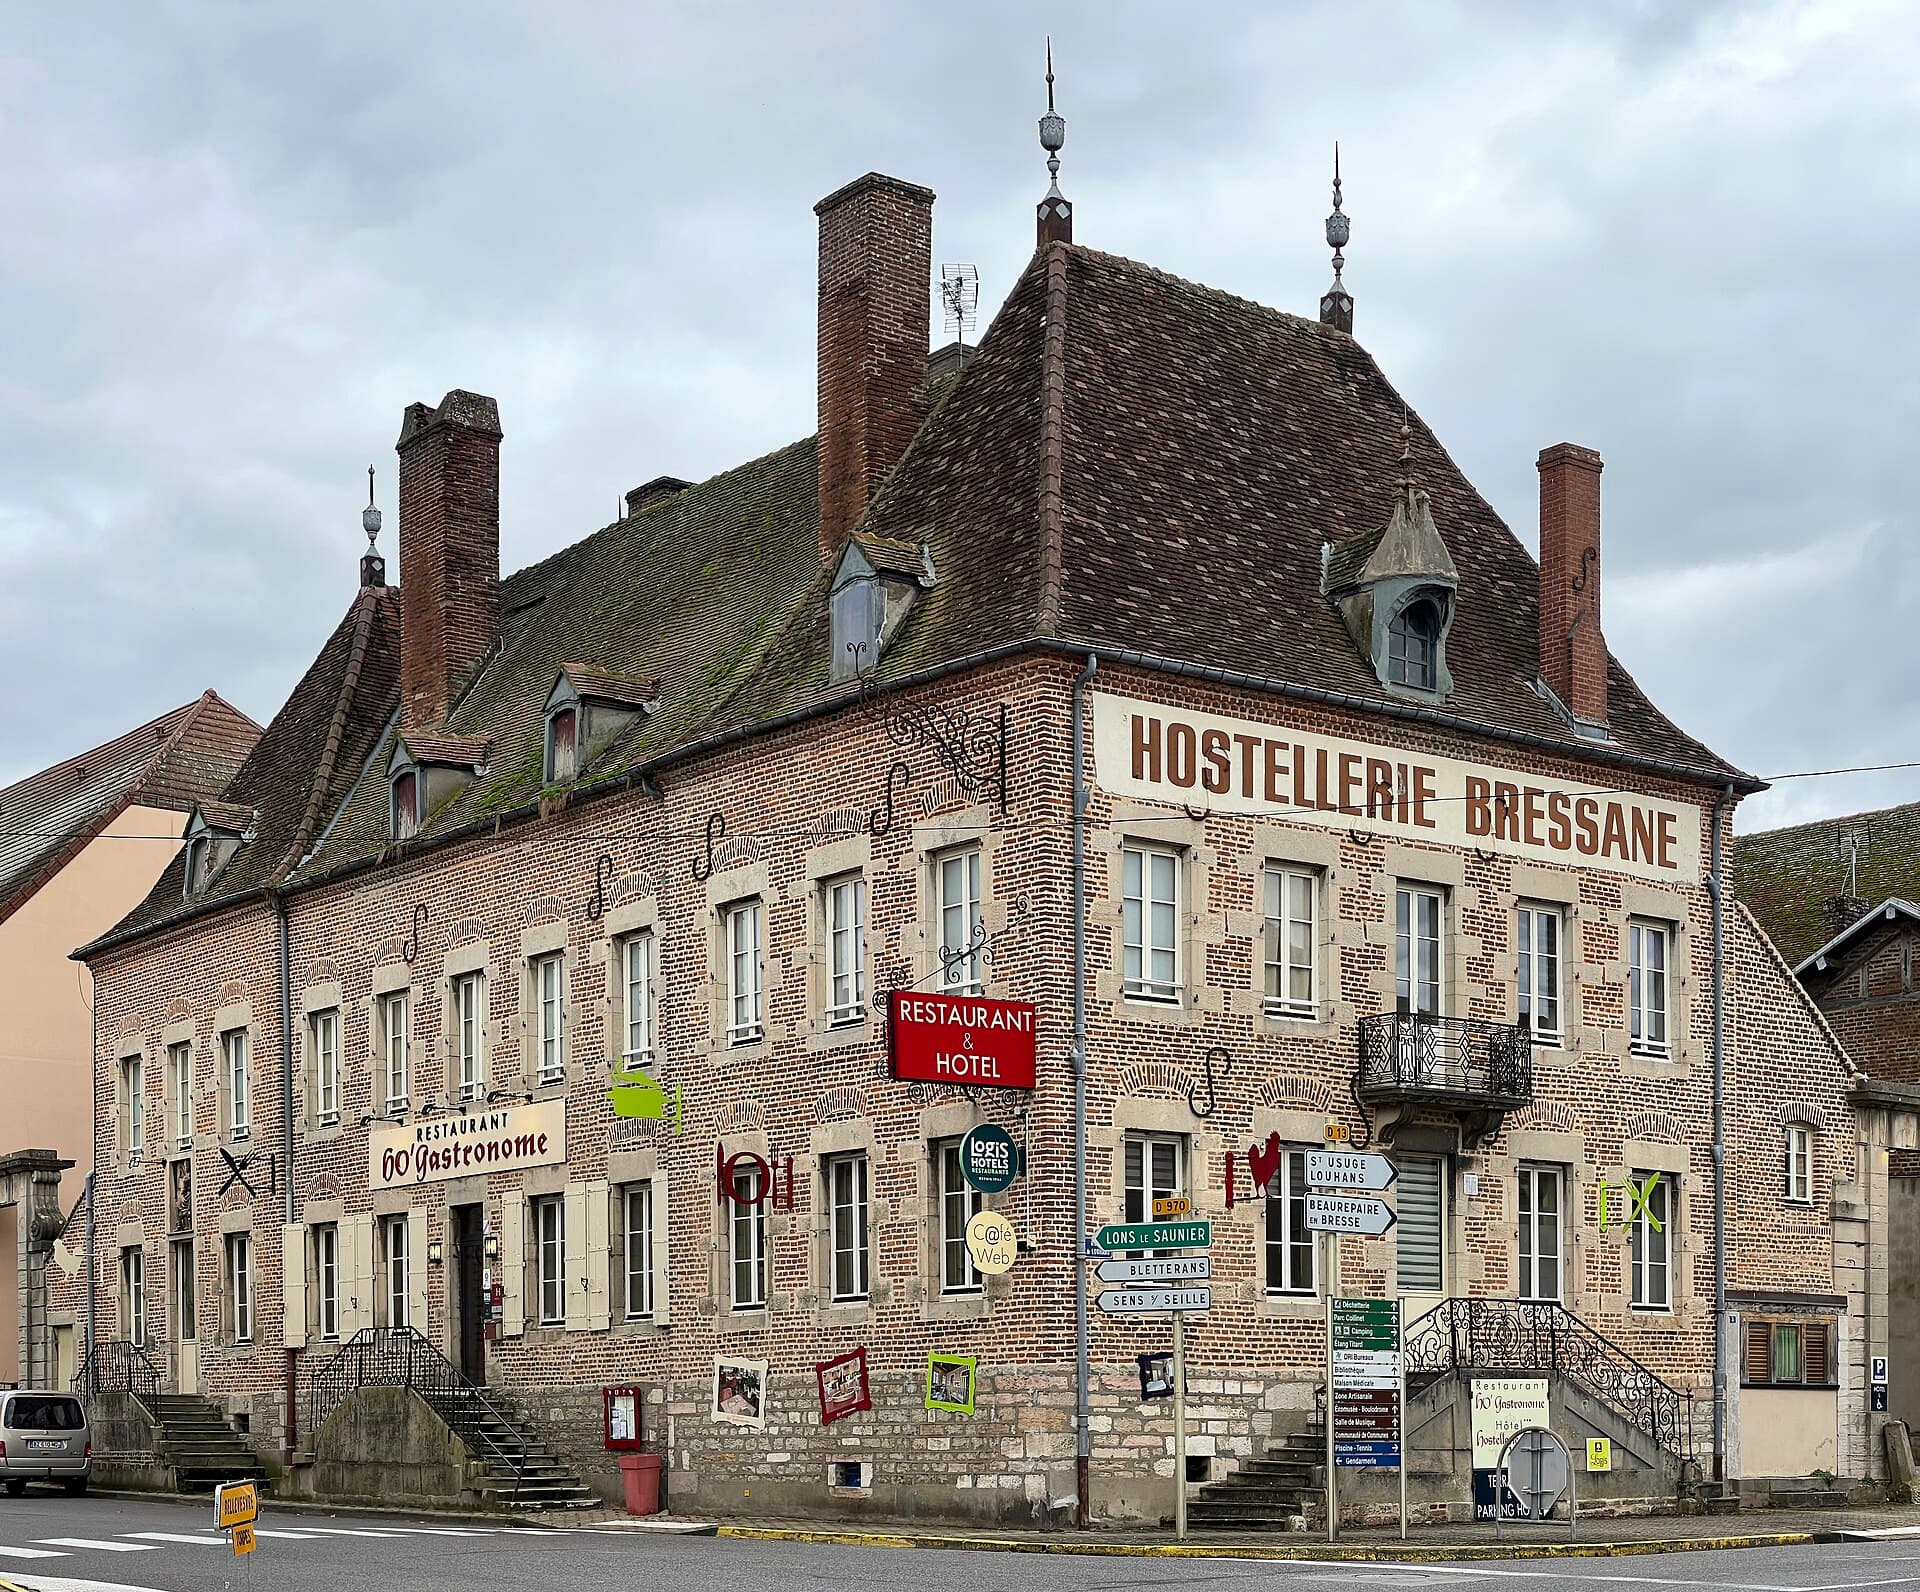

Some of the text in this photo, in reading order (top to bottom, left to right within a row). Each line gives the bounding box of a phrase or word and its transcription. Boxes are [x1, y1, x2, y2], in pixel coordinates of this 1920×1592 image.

[1130, 714, 1678, 871] HOSTELLERIE BRESSANE
[900, 1000, 1033, 1032] RESTAURANT
[963, 1032, 973, 1050] &
[936, 1053, 1001, 1078] HOTEL
[416, 1113, 509, 1142] RESTAURANT
[1327, 1125, 1348, 1138] D 13
[971, 1157, 1009, 1169] HOTELS
[1326, 1156, 1367, 1170] USUGE
[971, 1167, 1009, 1175] RESTAURANTS
[1309, 1170, 1365, 1184] LOUHANS
[1156, 1200, 1186, 1213] D 970
[1309, 1199, 1379, 1216] BEAUREPAIRE
[1309, 1214, 1361, 1228] EN BRESSE
[974, 1223, 1012, 1245] C@fé
[1106, 1226, 1206, 1245] LONS LE SAUNIER
[976, 1247, 1010, 1265] Web
[1130, 1261, 1206, 1276] BLETTERANS
[1113, 1295, 1144, 1306] SENS
[1164, 1293, 1206, 1306] SEILLE
[1351, 1327, 1373, 1336] Camping
[1334, 1366, 1365, 1375] Bibliothèque
[1876, 1359, 1884, 1374] P
[1334, 1379, 1353, 1387] Maison
[1476, 1380, 1545, 1391] Restaurant
[1334, 1392, 1373, 1400] Zone Artisanale
[1361, 1405, 1389, 1413] Boulodrome
[1494, 1395, 1545, 1413] Gastronome
[1334, 1418, 1376, 1427] Salle de Musique
[1495, 1420, 1523, 1431] Hôtel
[1366, 1431, 1389, 1439] Communes
[1334, 1444, 1353, 1452] Piscine
[1356, 1444, 1373, 1452] Tennis
[1345, 1457, 1377, 1465] Gendarmerie
